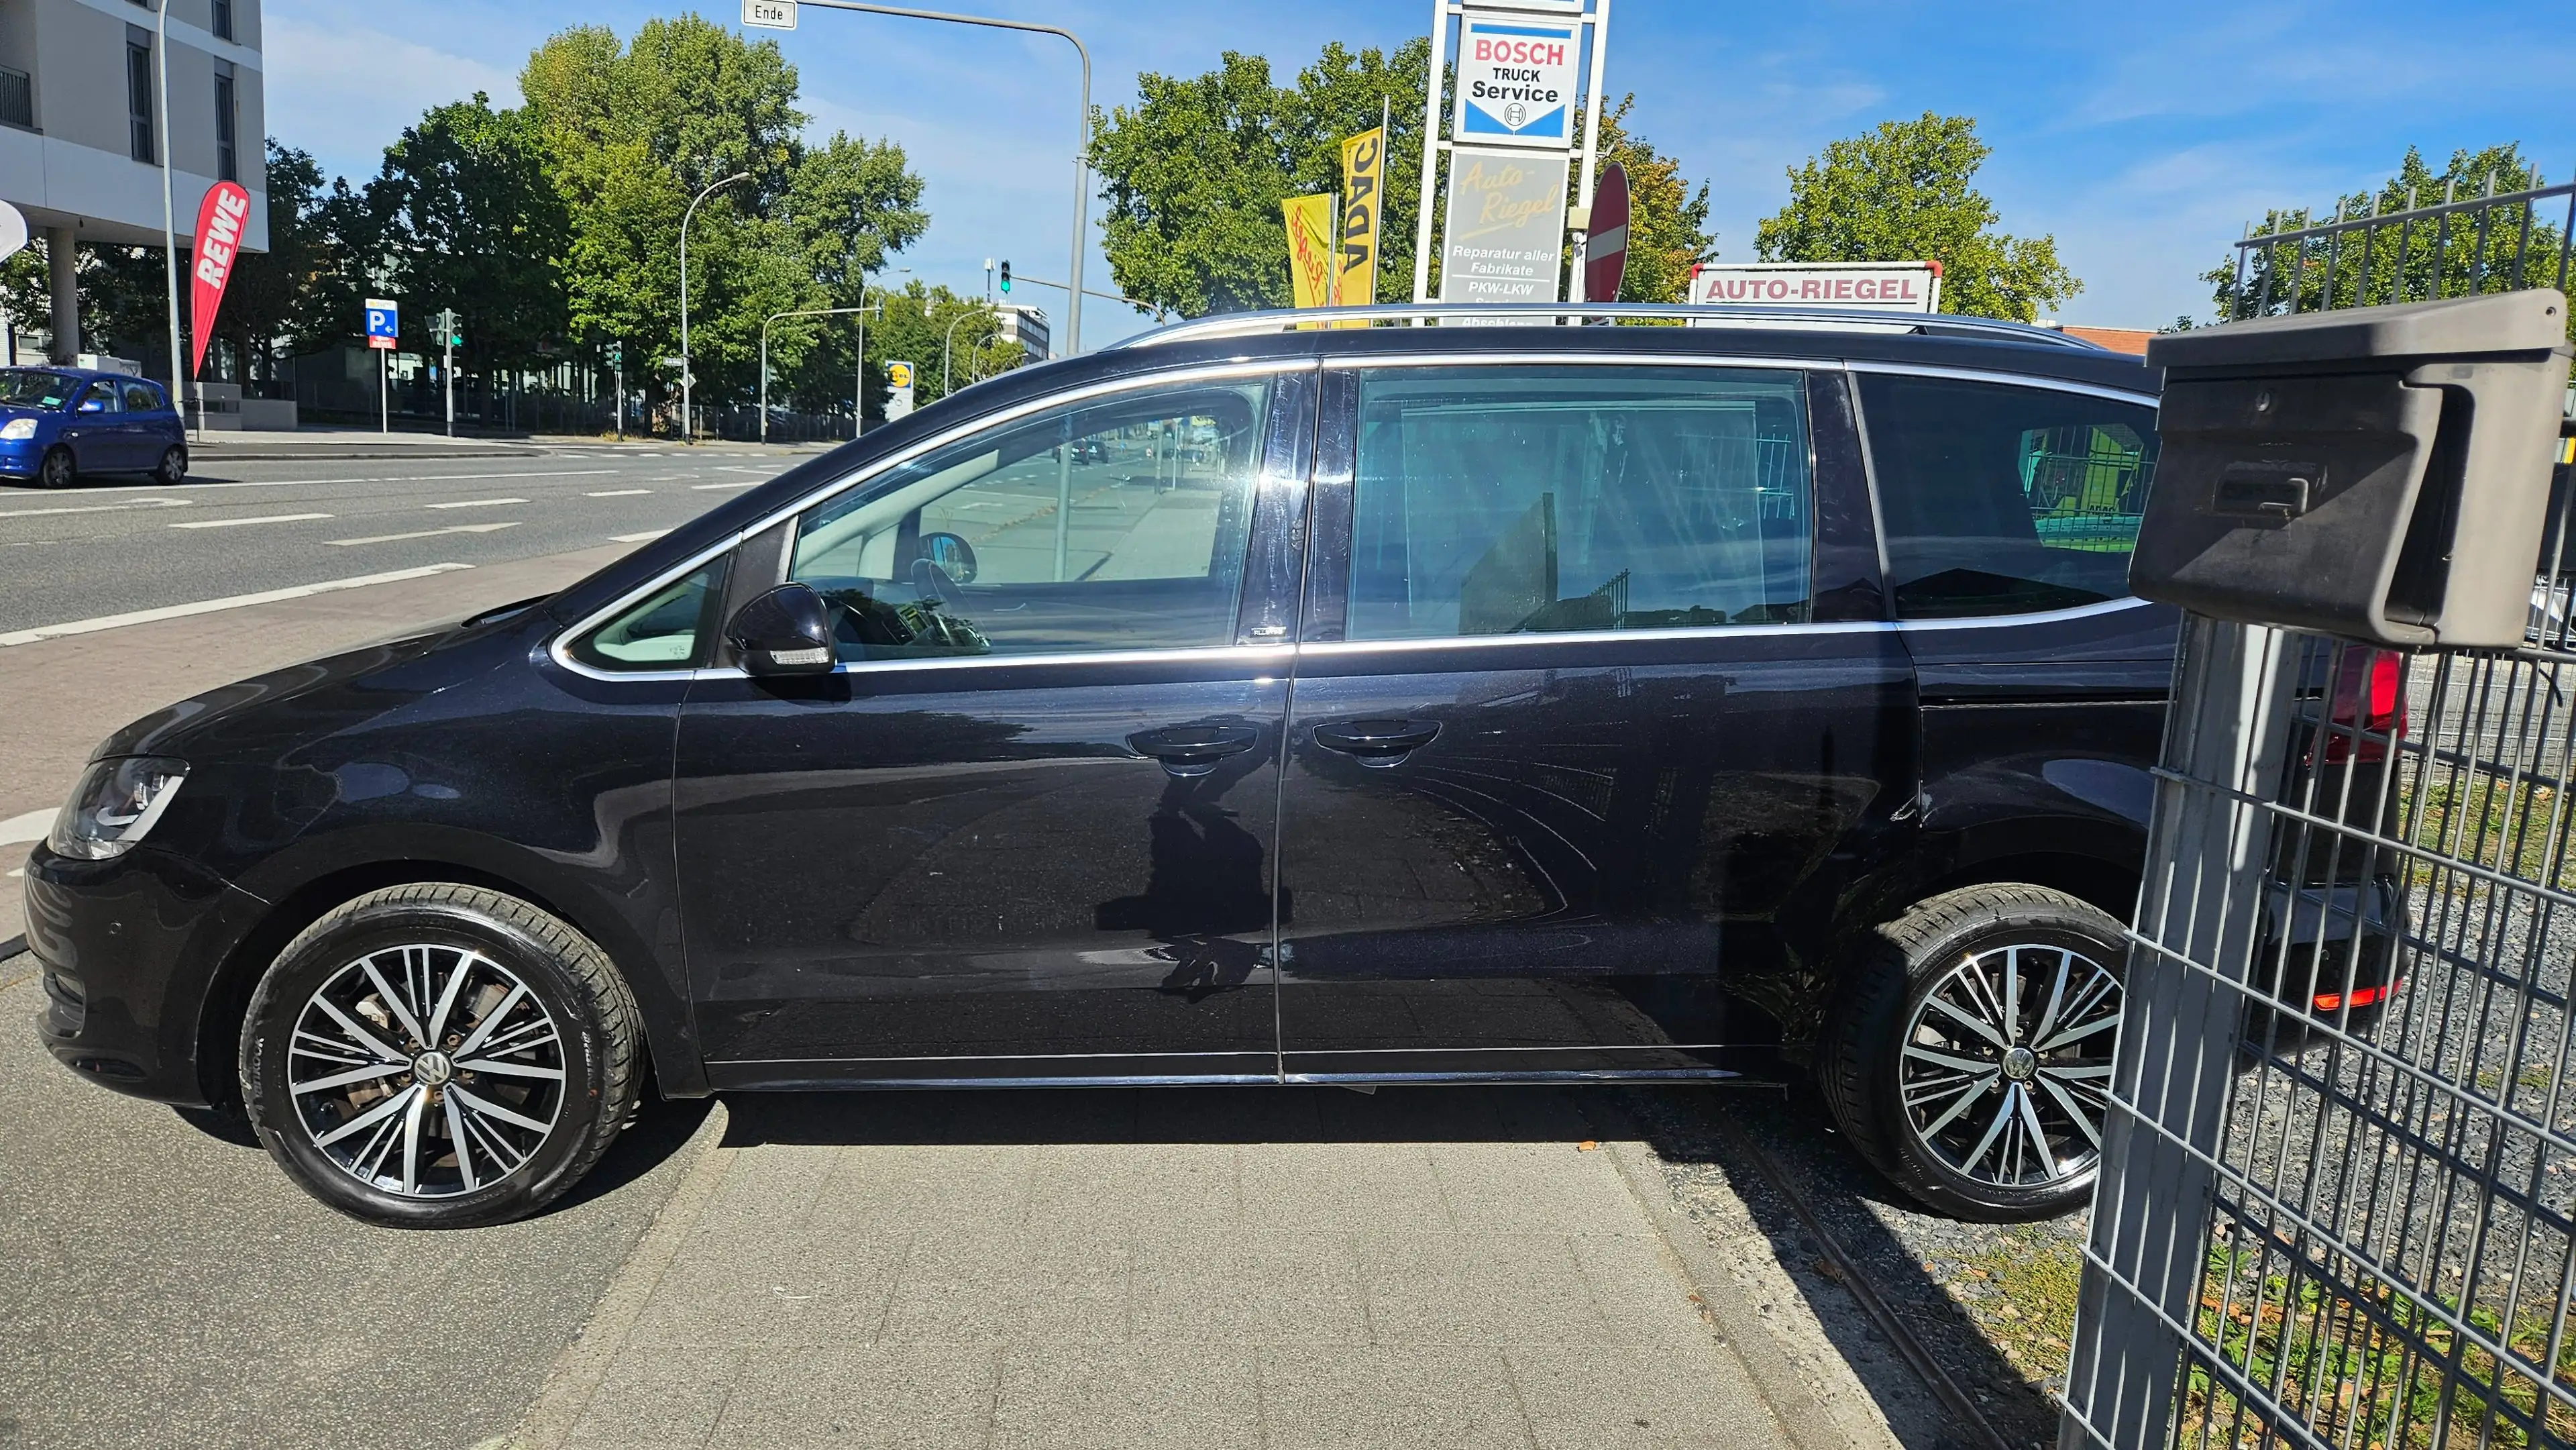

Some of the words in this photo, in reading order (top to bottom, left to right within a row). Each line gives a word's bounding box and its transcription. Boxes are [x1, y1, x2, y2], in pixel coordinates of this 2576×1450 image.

[755, 5, 784, 20] Ende
[1475, 39, 1564, 66] BOSCH
[1493, 67, 1541, 83] TRUCK
[1472, 81, 1558, 103] Service
[1460, 161, 1535, 196] Auto-
[1479, 180, 1560, 228] Riegel
[197, 188, 247, 291] REWE
[1452, 245, 1521, 261] Reparatur
[1523, 249, 1555, 262] aller
[1470, 262, 1534, 276] Fabrikate
[1468, 281, 1534, 296] PKW-LKW
[1706, 279, 1918, 299] AUTO-RIEGEL
[369, 311, 386, 333] P
